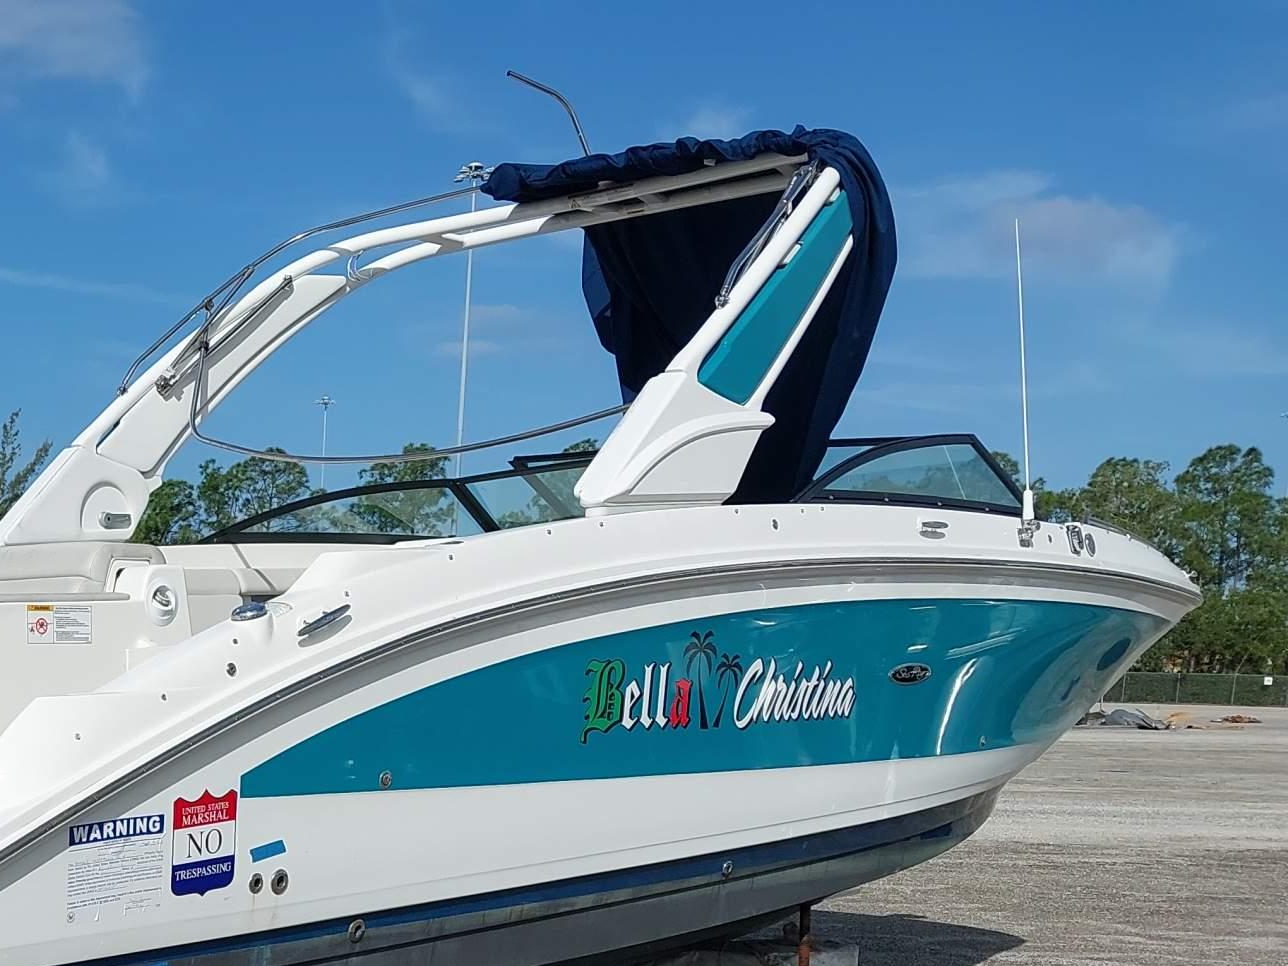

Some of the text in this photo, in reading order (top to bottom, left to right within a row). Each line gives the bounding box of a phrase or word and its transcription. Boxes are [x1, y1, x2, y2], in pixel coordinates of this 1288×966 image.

[580, 656, 856, 744] Bella Christina
[181, 801, 230, 815] UNITED STATES
[181, 810, 230, 827] MARSHAL
[72, 815, 161, 844] WARNING
[186, 828, 223, 859] NO
[174, 861, 232, 881] TRESPASSING
